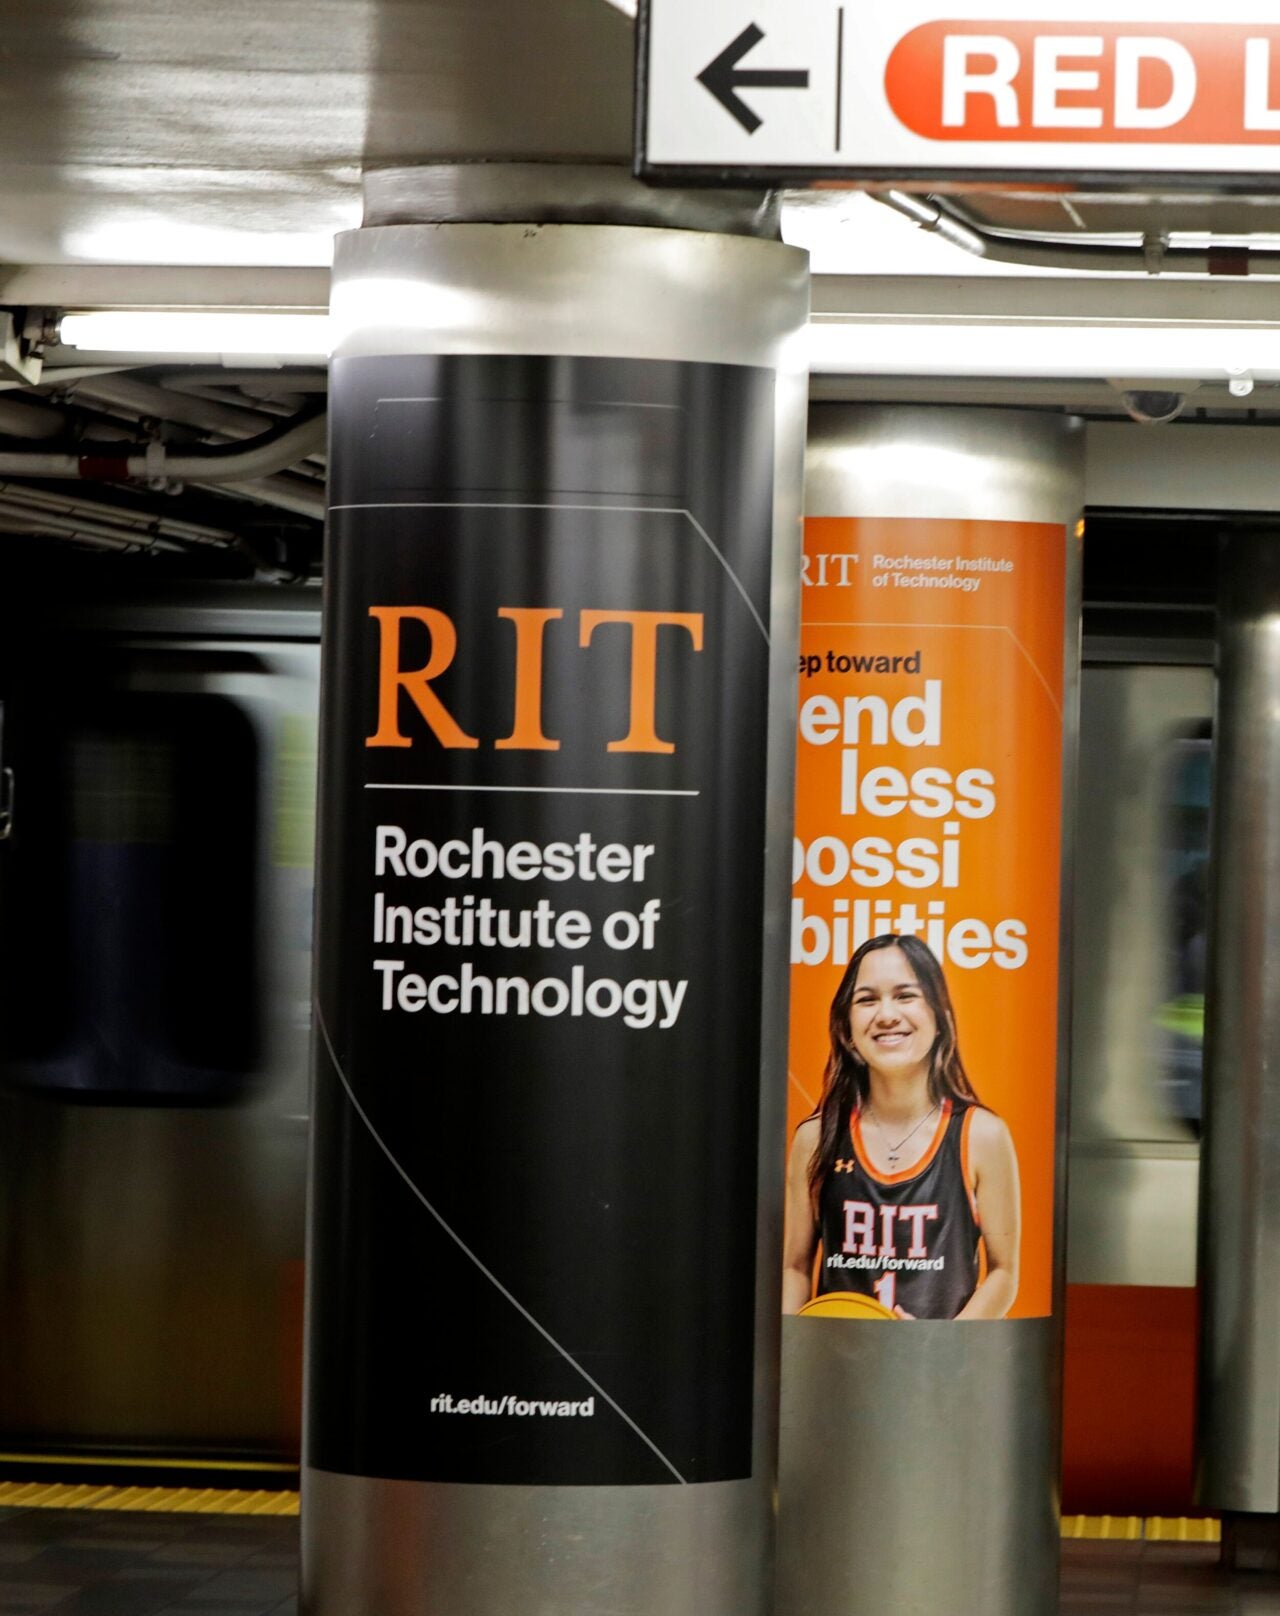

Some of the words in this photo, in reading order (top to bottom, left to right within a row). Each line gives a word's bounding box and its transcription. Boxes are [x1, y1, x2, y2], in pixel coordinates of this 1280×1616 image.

[941, 33, 1197, 131] RED
[872, 554, 954, 571] Rochester
[956, 556, 1014, 572] Institute
[872, 573, 889, 588] of
[893, 573, 982, 592] Technology
[365, 605, 704, 754] RIT
[827, 650, 922, 674] toward
[799, 679, 942, 748] end
[841, 748, 996, 820] less
[374, 825, 656, 883] Rochester
[373, 892, 592, 949] Institute
[602, 898, 661, 951] of
[373, 959, 689, 1030] Technology
[842, 1200, 938, 1258] RIT
[827, 1253, 945, 1271] rit.edu/forward
[430, 1393, 595, 1417] rit.edu/forward
